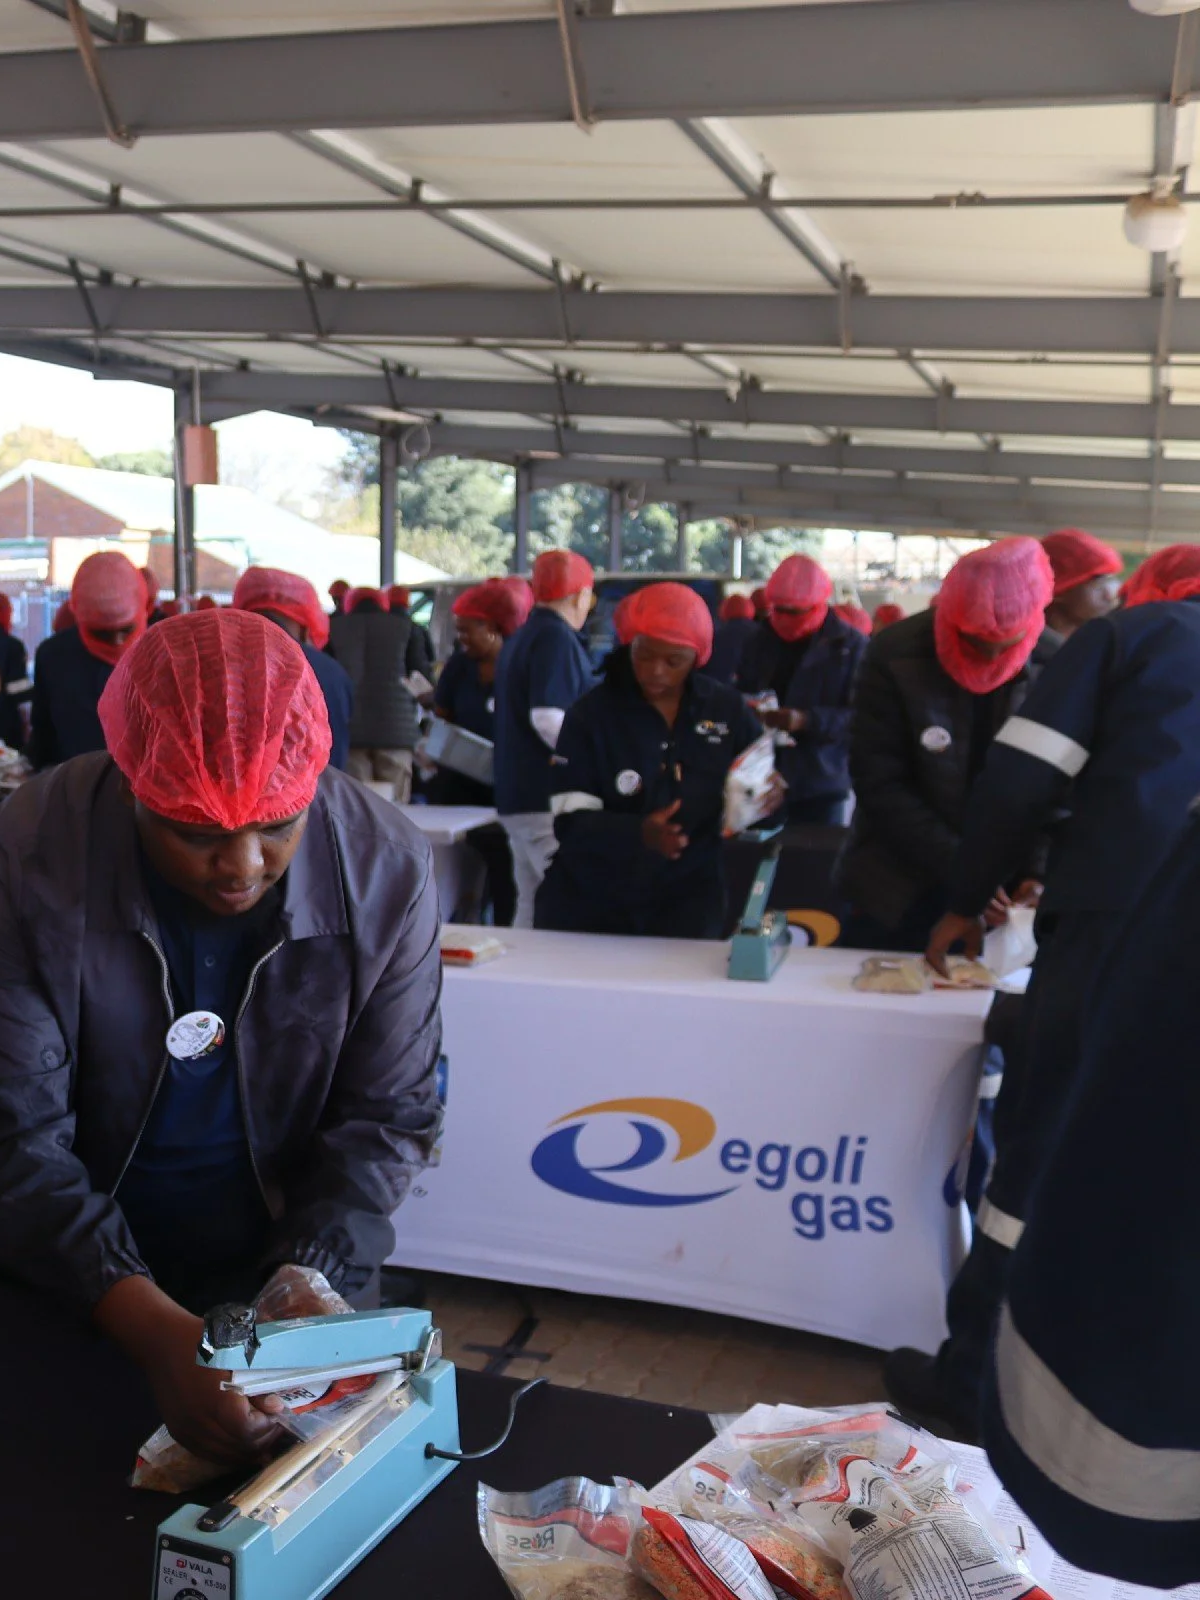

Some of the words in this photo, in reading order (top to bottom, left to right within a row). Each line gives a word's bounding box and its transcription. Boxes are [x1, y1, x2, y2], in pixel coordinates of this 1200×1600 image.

[720, 1135, 869, 1191] egoli
[791, 1191, 895, 1241] gas
[188, 1561, 213, 1576] VALA
